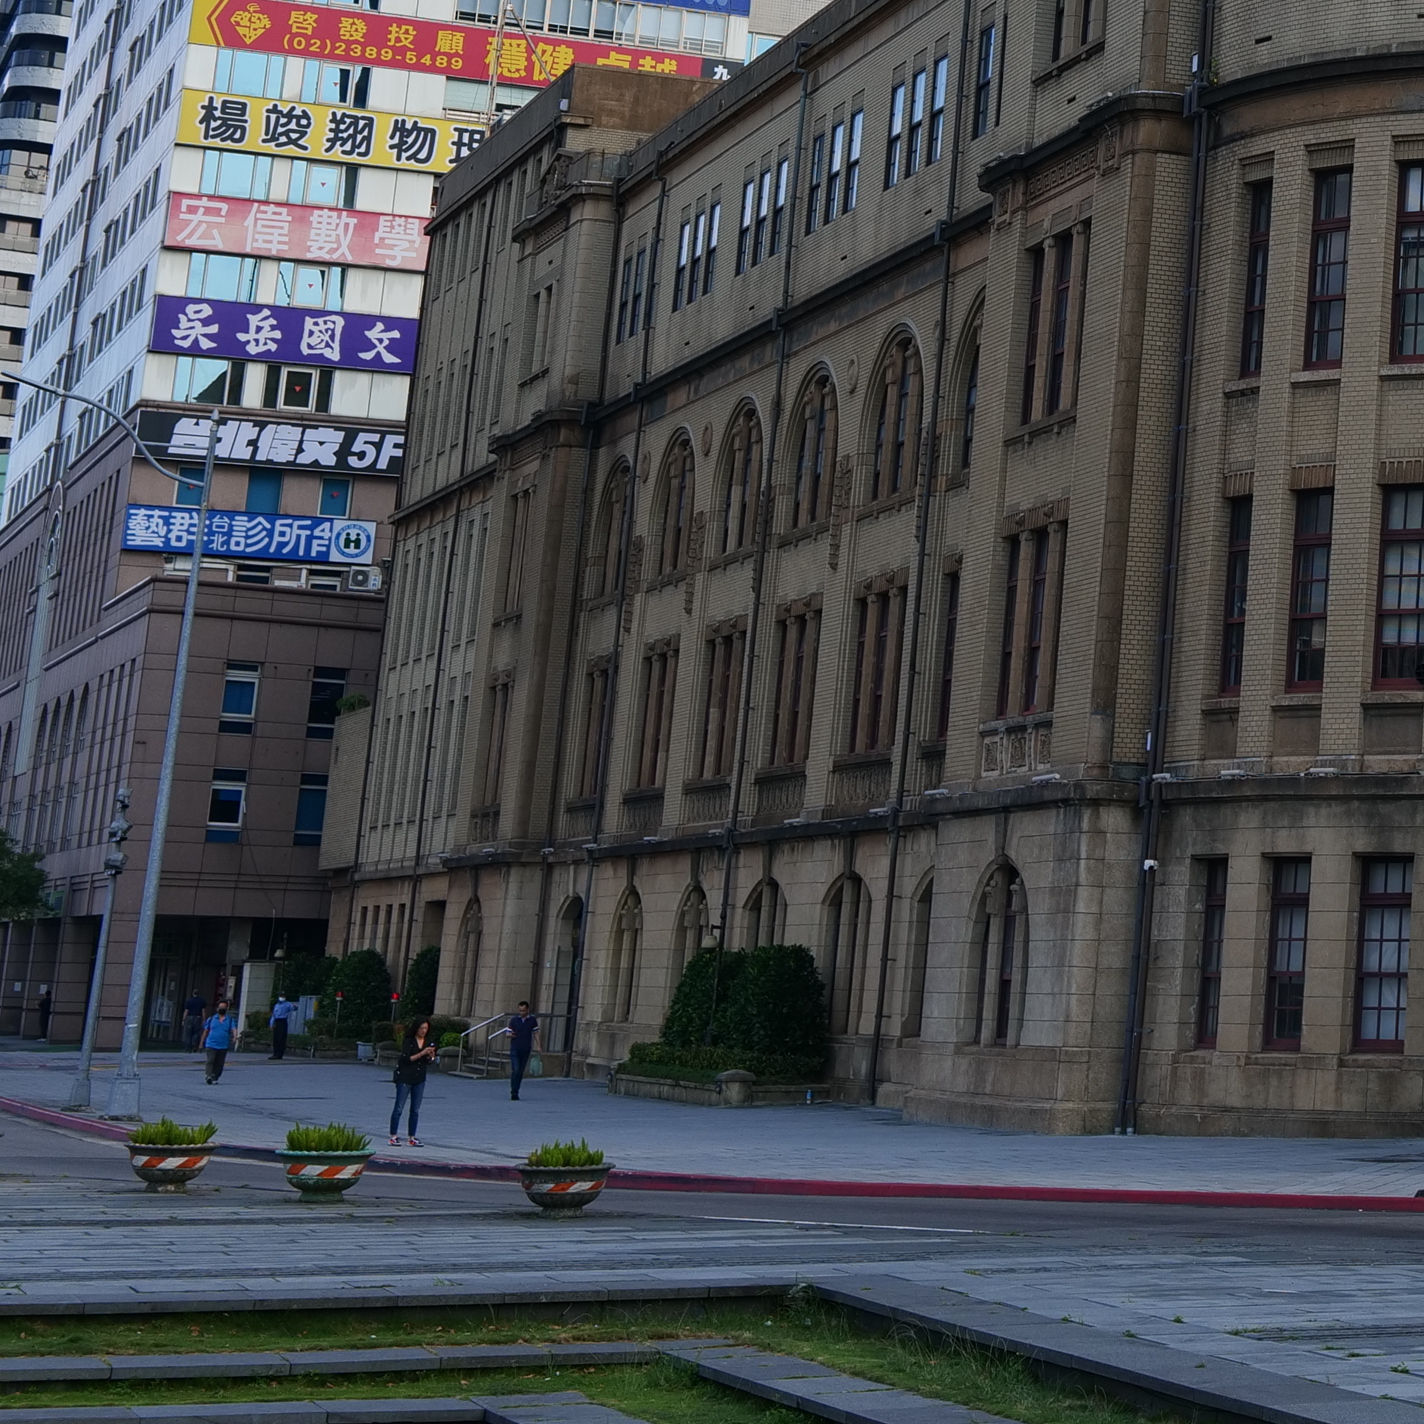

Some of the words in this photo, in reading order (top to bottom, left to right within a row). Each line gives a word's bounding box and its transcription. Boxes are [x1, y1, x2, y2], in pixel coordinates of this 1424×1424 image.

[283, 34, 463, 70] (02)2389-5489
[175, 197, 421, 266] 宏偉數學
[170, 303, 402, 364] 吳岳國文
[347, 432, 405, 469] 5F
[126, 507, 209, 547] 藝群
[209, 514, 230, 551] 台北
[230, 516, 311, 556] 診所
[311, 521, 332, 557] 4F
